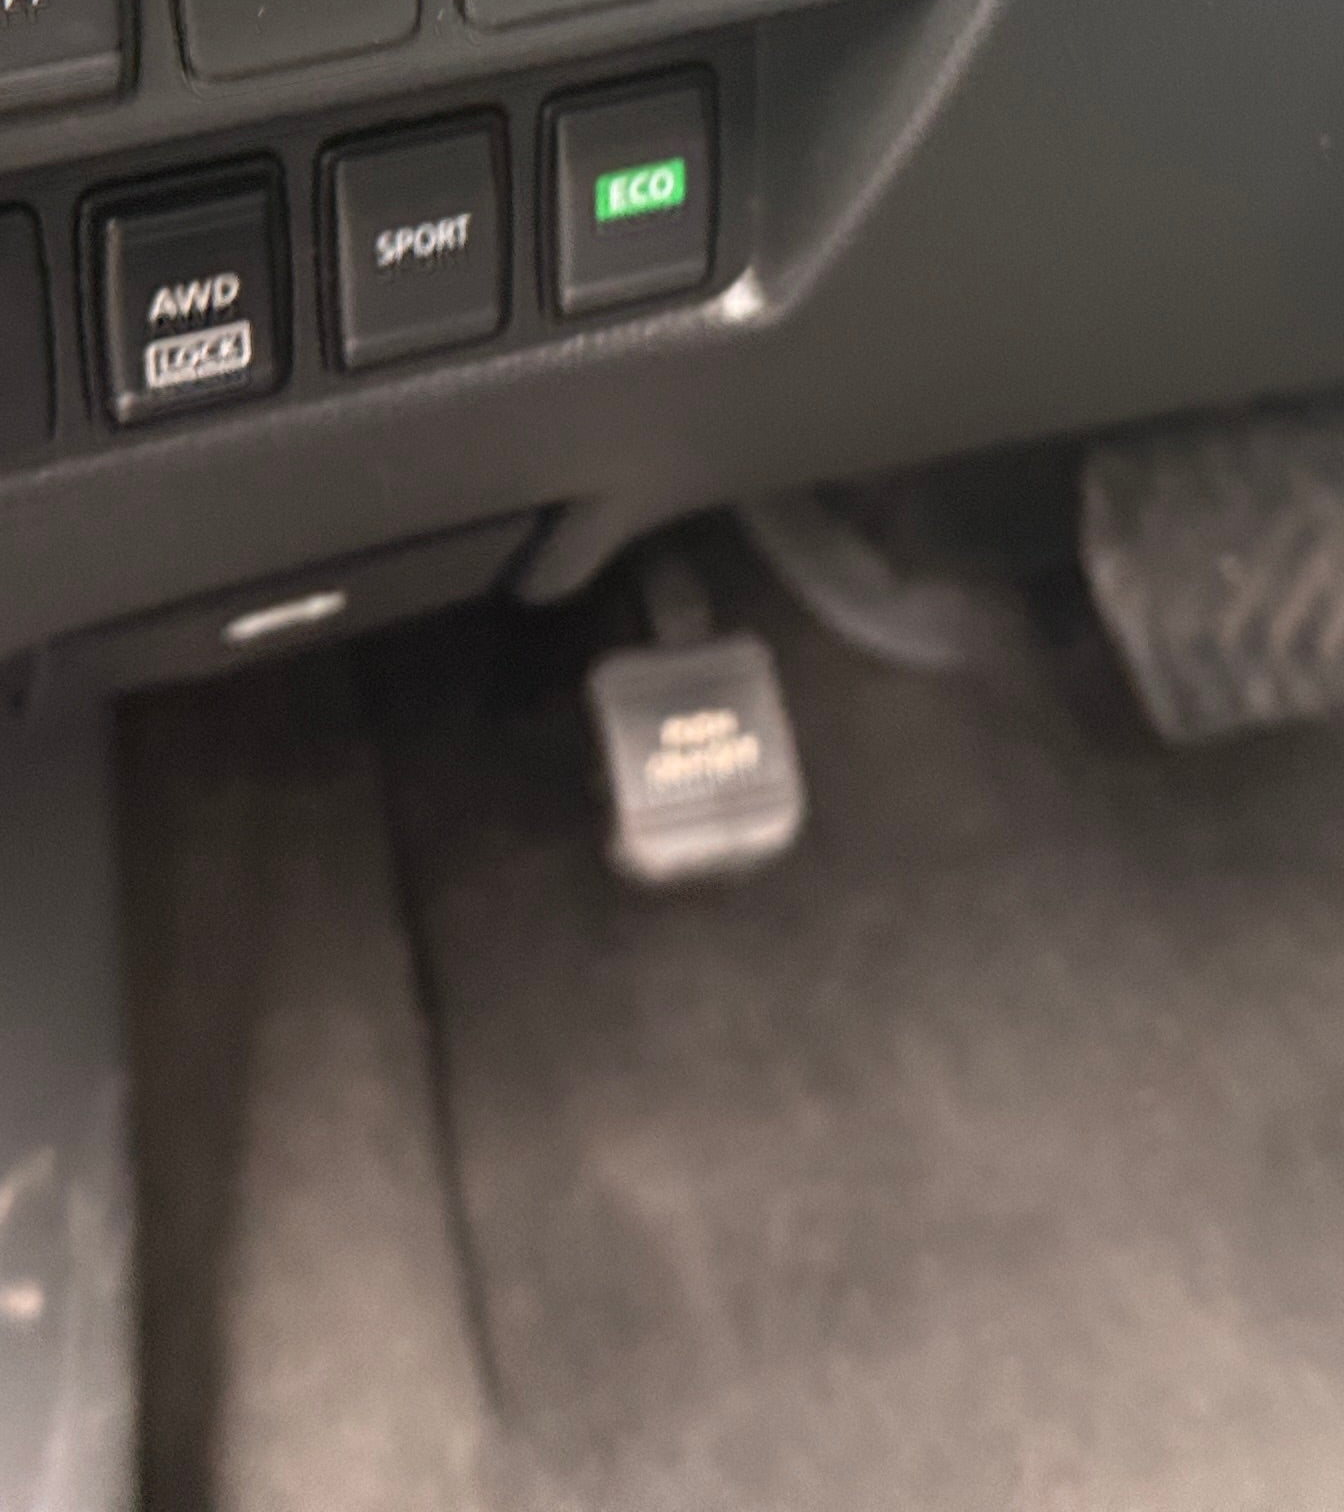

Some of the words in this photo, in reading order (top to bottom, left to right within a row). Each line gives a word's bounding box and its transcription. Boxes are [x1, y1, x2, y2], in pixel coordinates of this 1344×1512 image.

[606, 166, 676, 213] ECO
[375, 211, 471, 267] SPORT
[148, 272, 240, 324] AWD
